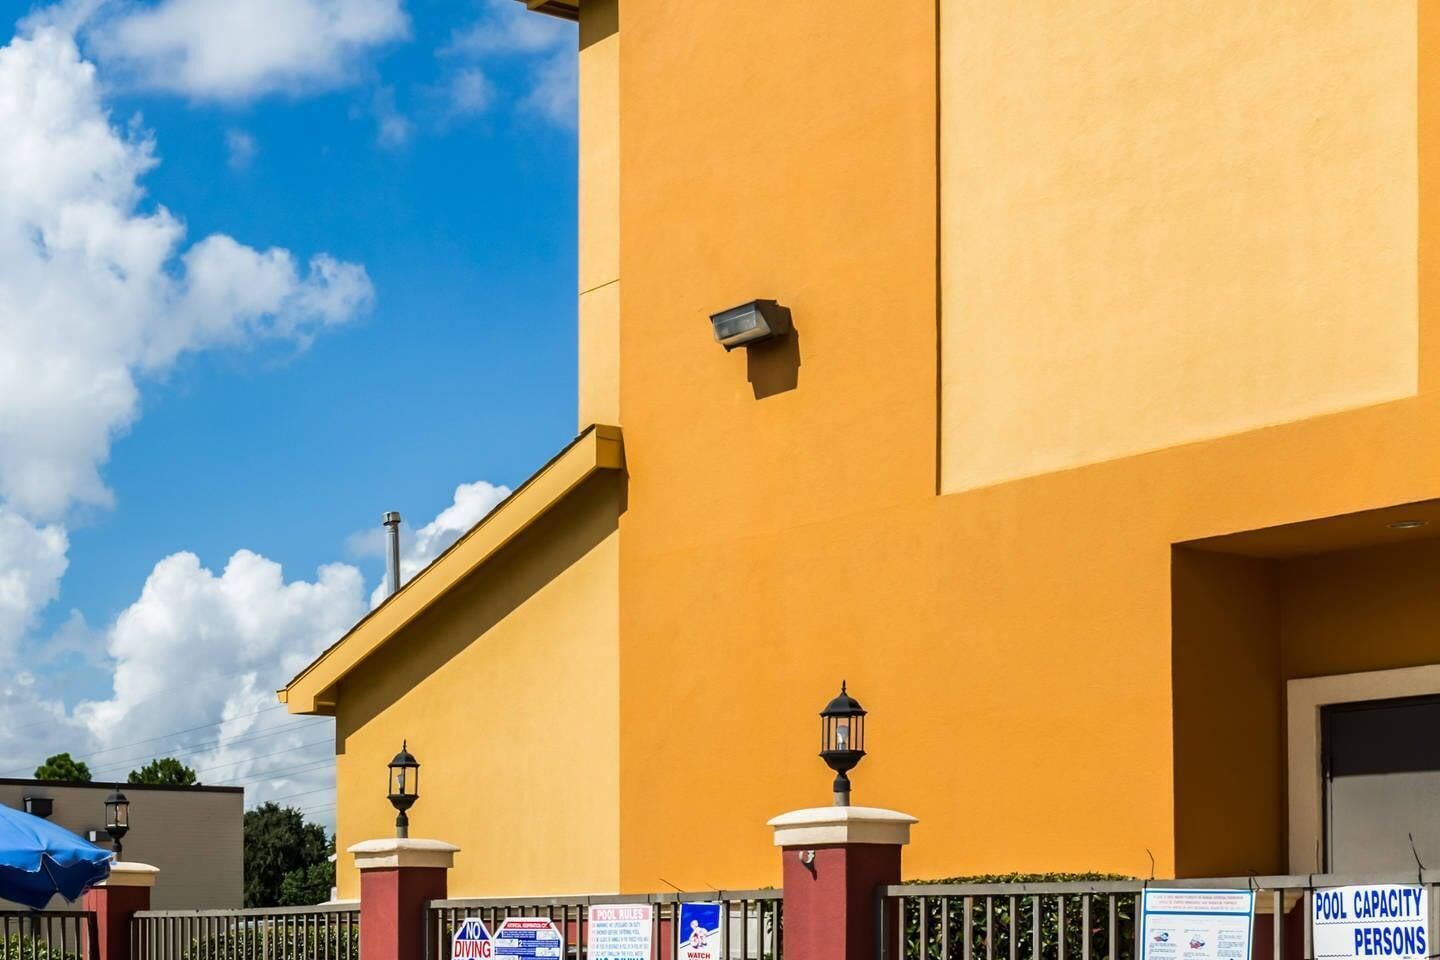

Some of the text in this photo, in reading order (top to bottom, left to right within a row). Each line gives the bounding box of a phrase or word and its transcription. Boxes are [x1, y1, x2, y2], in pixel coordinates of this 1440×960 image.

[1316, 888, 1423, 920] POOL CAPACITY
[597, 909, 644, 920] POOL RULES
[466, 922, 481, 939] NO
[454, 940, 491, 958] DIVING
[1354, 926, 1426, 956] PERSONS
[687, 952, 710, 960] WATCH
